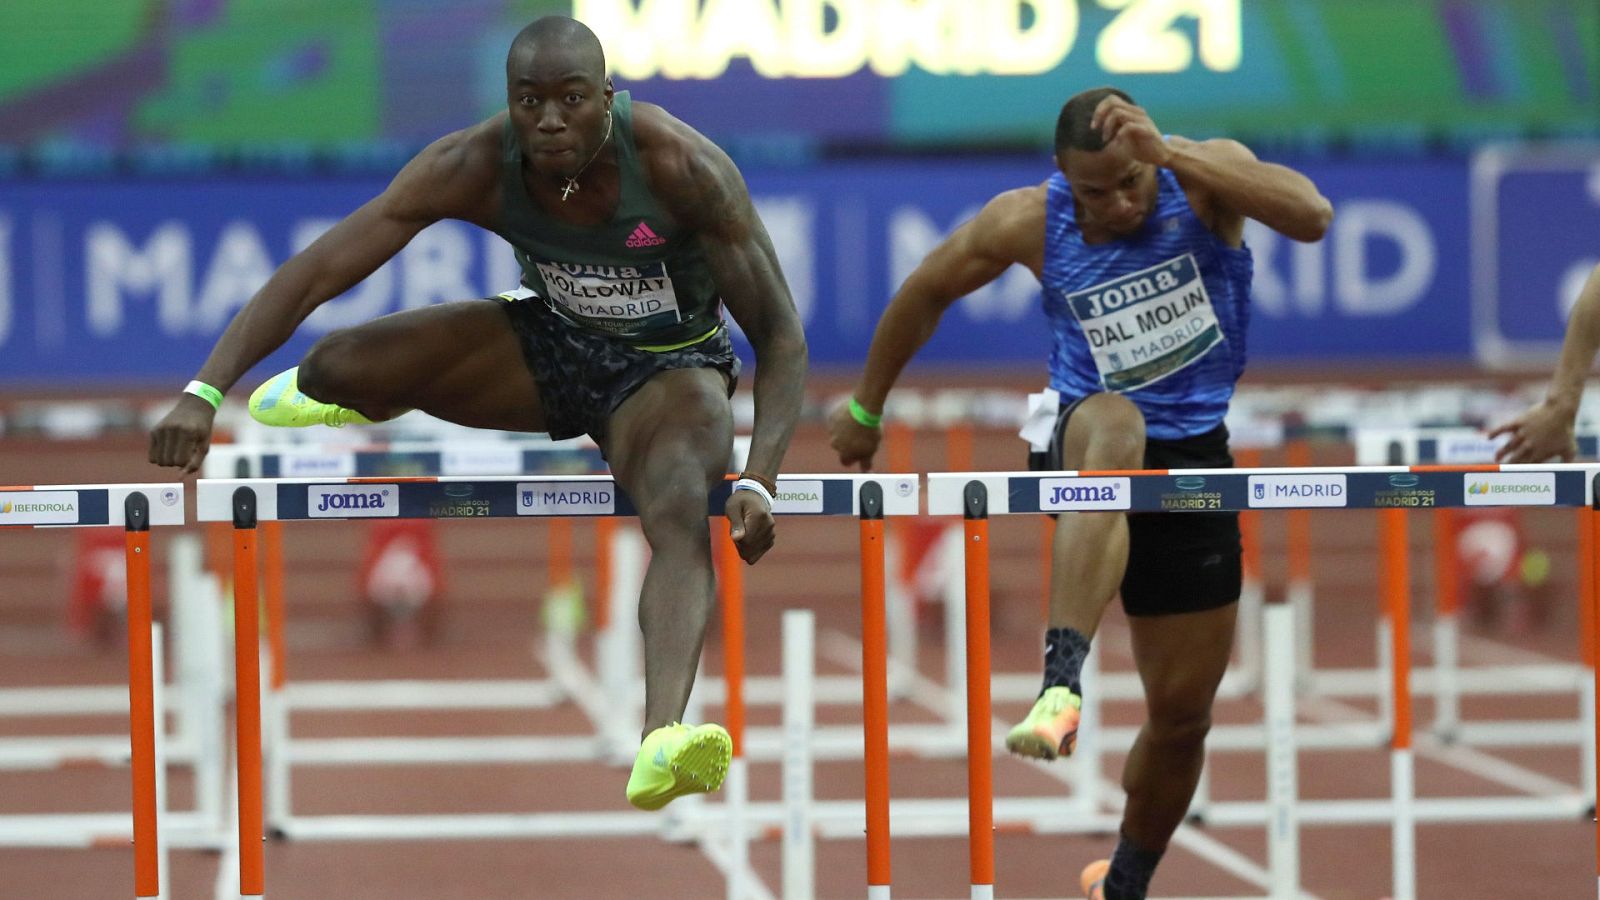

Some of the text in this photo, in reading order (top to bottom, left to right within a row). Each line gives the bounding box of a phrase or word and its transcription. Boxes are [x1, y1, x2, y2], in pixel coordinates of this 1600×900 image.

[1096, 0, 1242, 74] 21
[625, 236, 667, 248] adidas
[540, 268, 666, 298] HOLLOWAY
[578, 299, 662, 317] MADRID
[1088, 287, 1206, 348] DAL MOLIN
[1131, 316, 1205, 362] MADRID
[1275, 484, 1343, 497] MADRID
[1491, 484, 1551, 493] IBERDROLA
[543, 492, 611, 505] MADRID
[1161, 499, 1221, 509] MADRID 21
[1374, 497, 1435, 506] MADRID 21
[14, 503, 74, 512] IBERDROLA
[429, 507, 490, 516] MADRID 21
